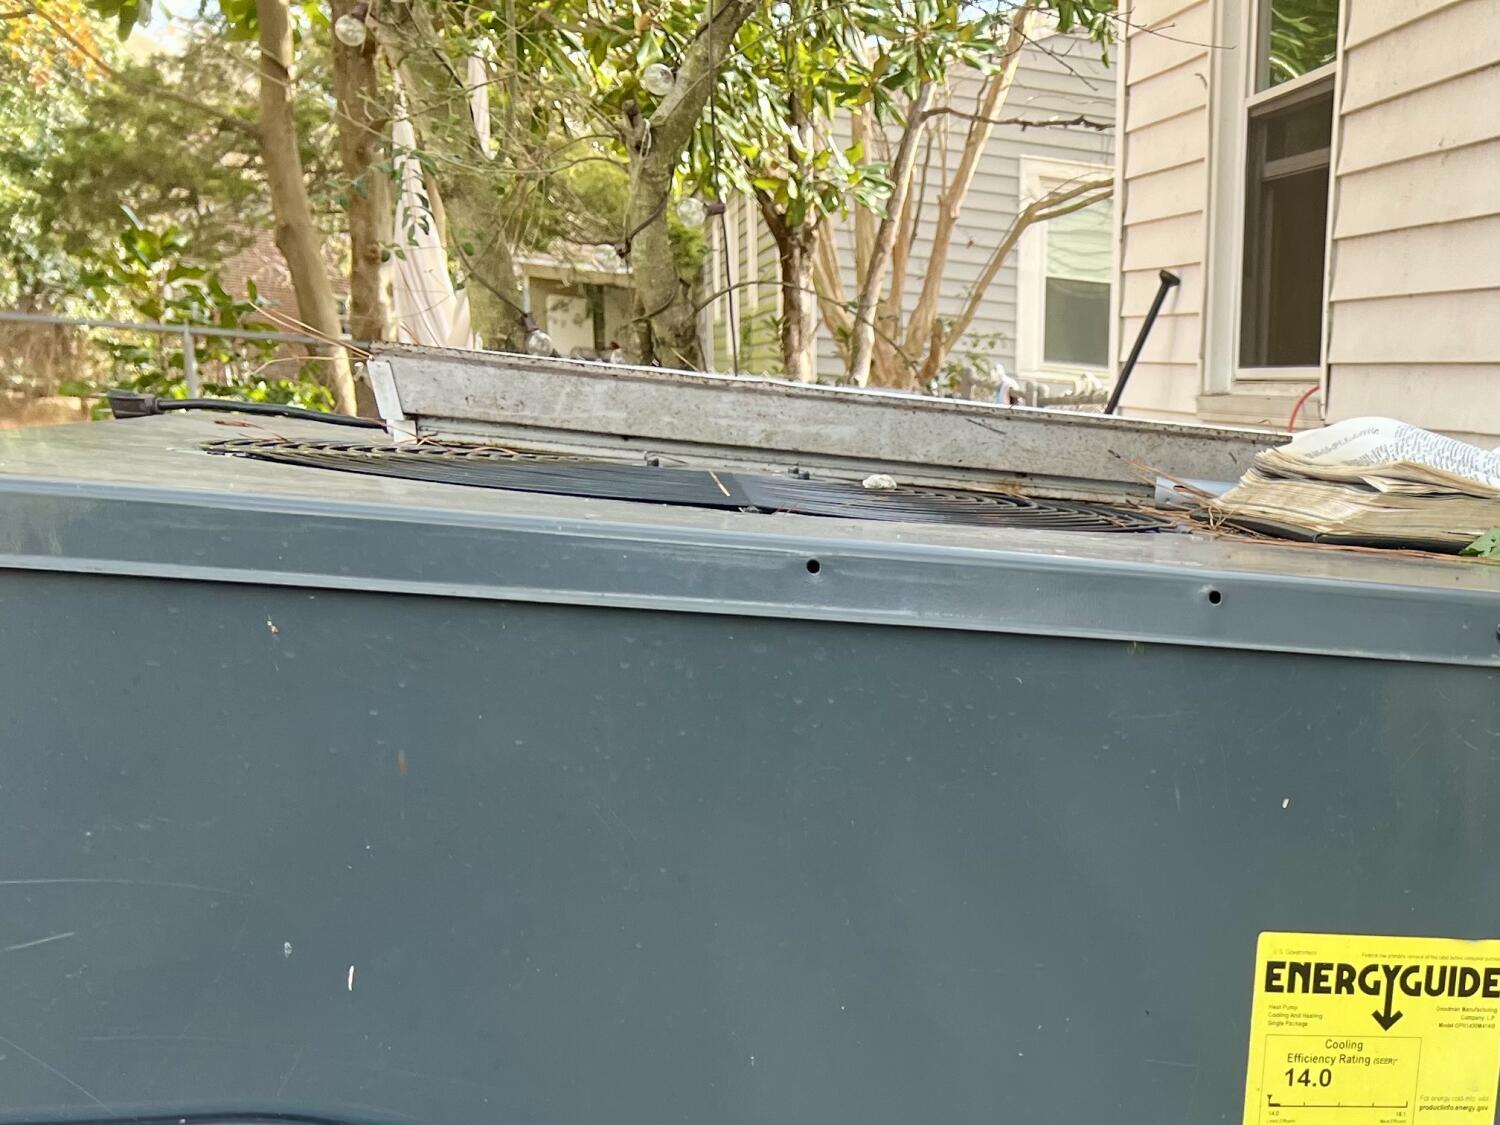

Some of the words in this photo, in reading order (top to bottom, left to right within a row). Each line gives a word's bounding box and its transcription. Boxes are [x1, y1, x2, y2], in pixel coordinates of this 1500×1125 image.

[1325, 1039, 1363, 1051] Cooling
[1287, 1053, 1336, 1065] Efficiency
[1339, 1054, 1371, 1066] Rating
[1285, 1067, 1332, 1087] 14.0
